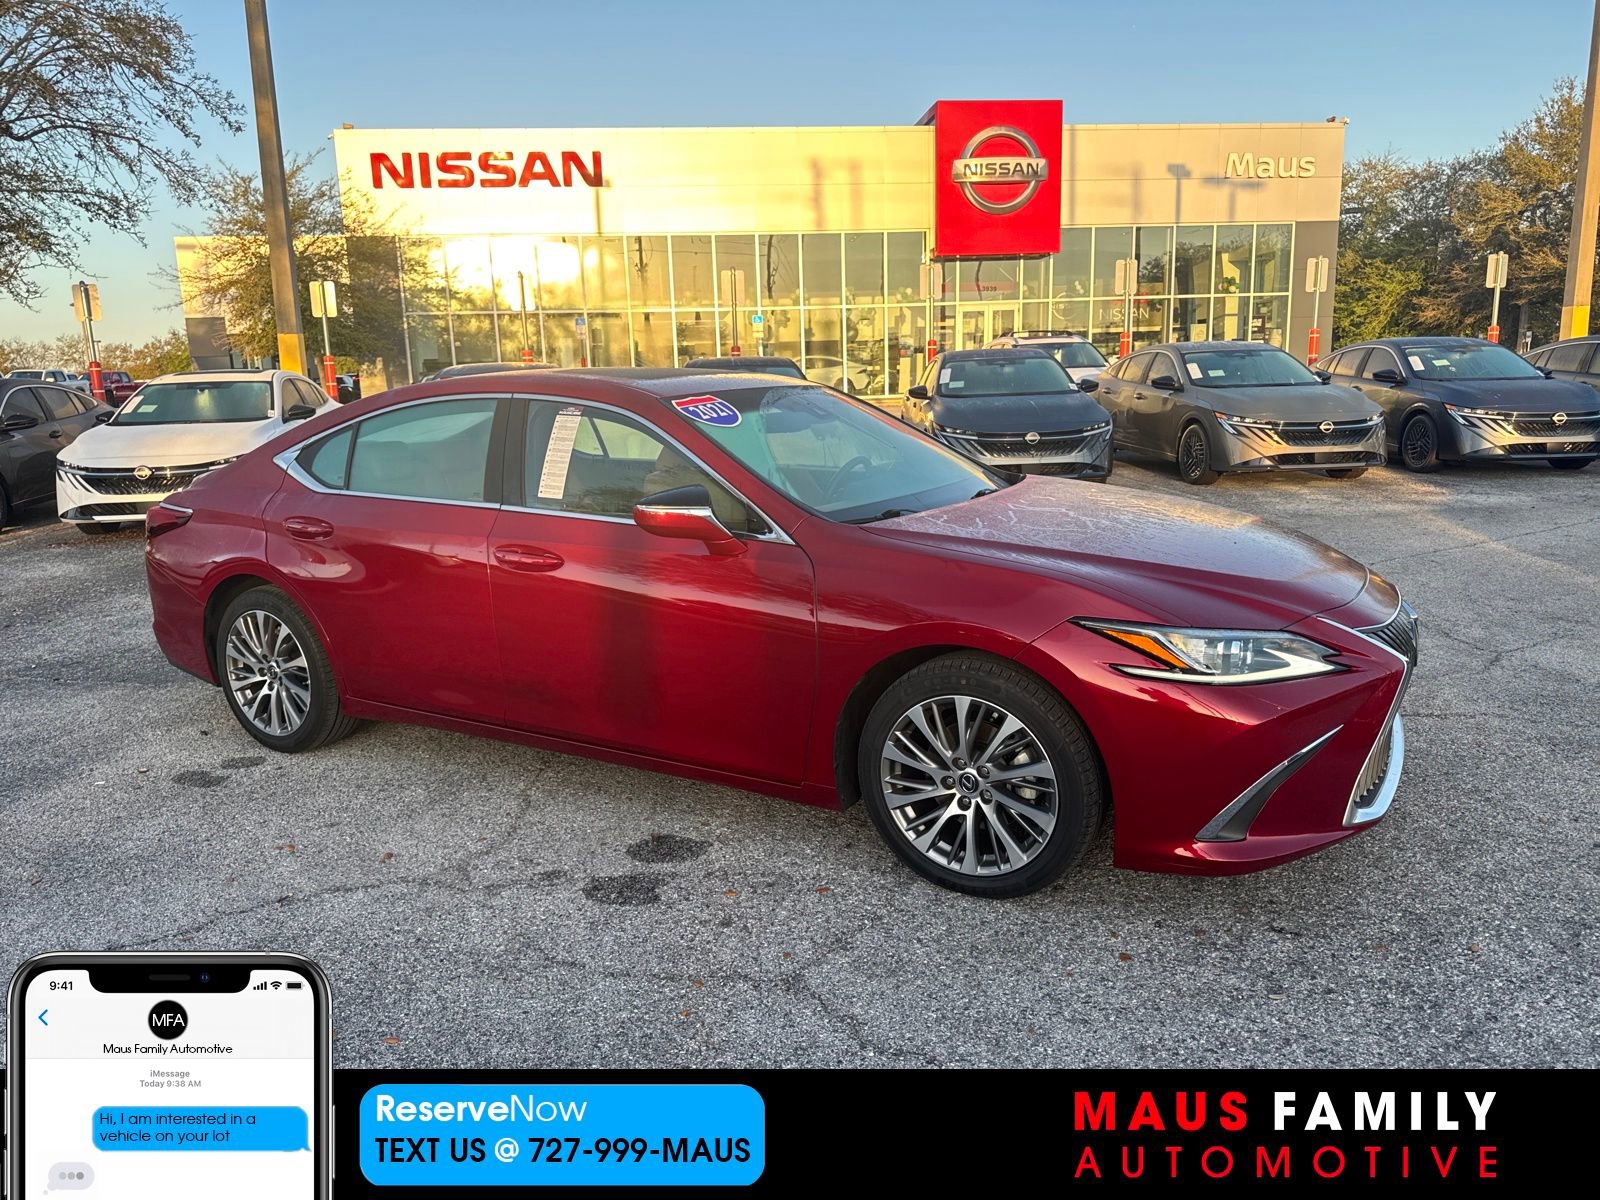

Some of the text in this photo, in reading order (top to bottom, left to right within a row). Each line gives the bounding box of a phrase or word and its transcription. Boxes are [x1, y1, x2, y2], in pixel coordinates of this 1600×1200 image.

[370, 151, 603, 189] NISSAN
[963, 162, 1040, 177] NISSAN
[1224, 152, 1316, 179] Maus
[688, 402, 734, 420] 2021
